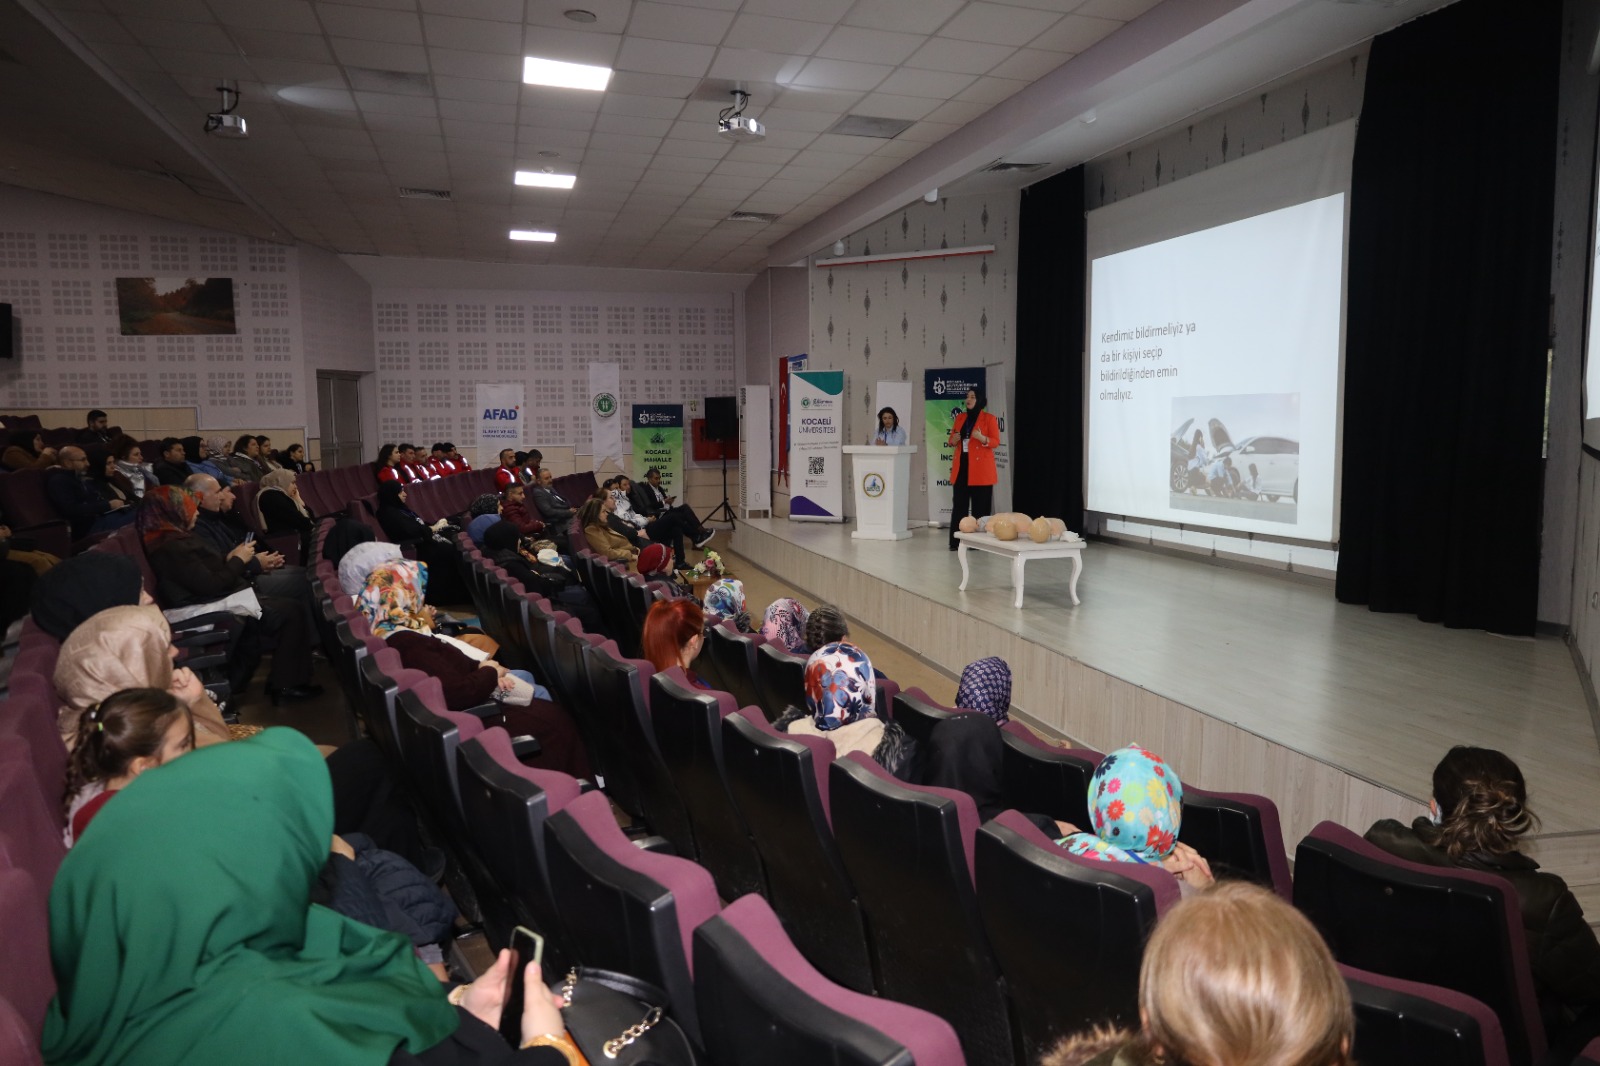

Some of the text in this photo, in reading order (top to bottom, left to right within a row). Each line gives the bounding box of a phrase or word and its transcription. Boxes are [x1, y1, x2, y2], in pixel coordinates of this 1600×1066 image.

[1101, 321, 1196, 344] Kendimiz bildirmeliyiz ya
[1100, 345, 1163, 363] da bir kişiyi seçip
[1100, 365, 1178, 382] bildirildiğinden emin
[483, 408, 518, 420] AFAD
[802, 416, 832, 425] KOCAELİ
[798, 426, 836, 434] ÜNİVERSİTESİ
